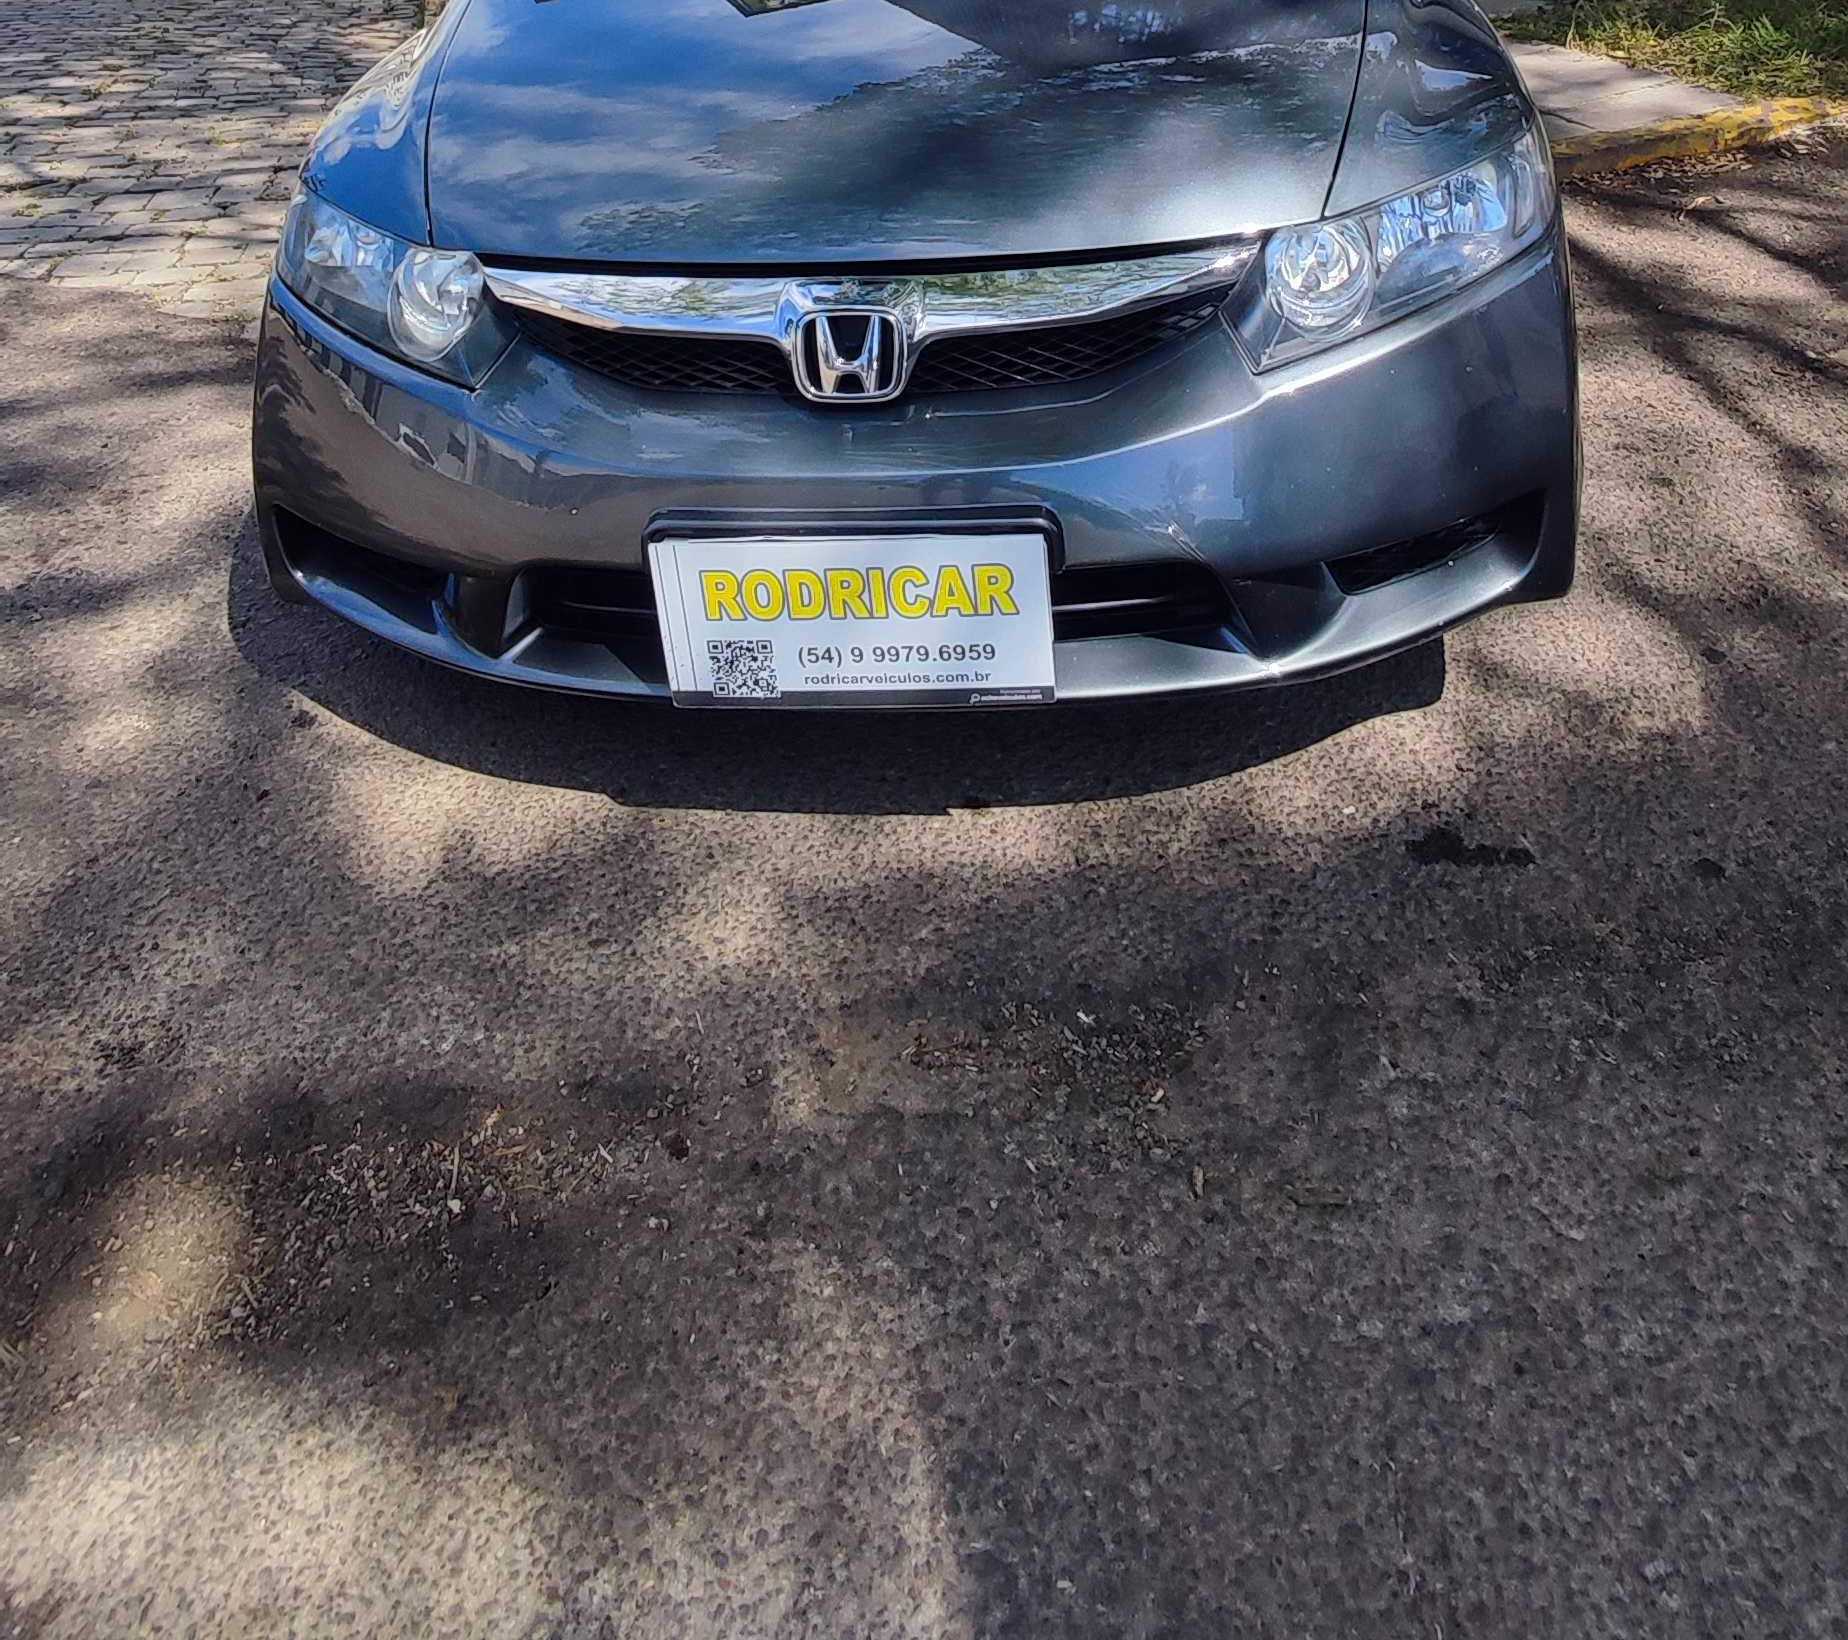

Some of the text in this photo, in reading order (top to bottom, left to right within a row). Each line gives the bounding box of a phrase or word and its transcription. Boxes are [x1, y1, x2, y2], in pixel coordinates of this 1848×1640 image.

[699, 563, 1019, 621] RODRICAR
[798, 643, 996, 668] (54) 9 9979.6959
[804, 671, 992, 685] rodricarveiculos.com.br
